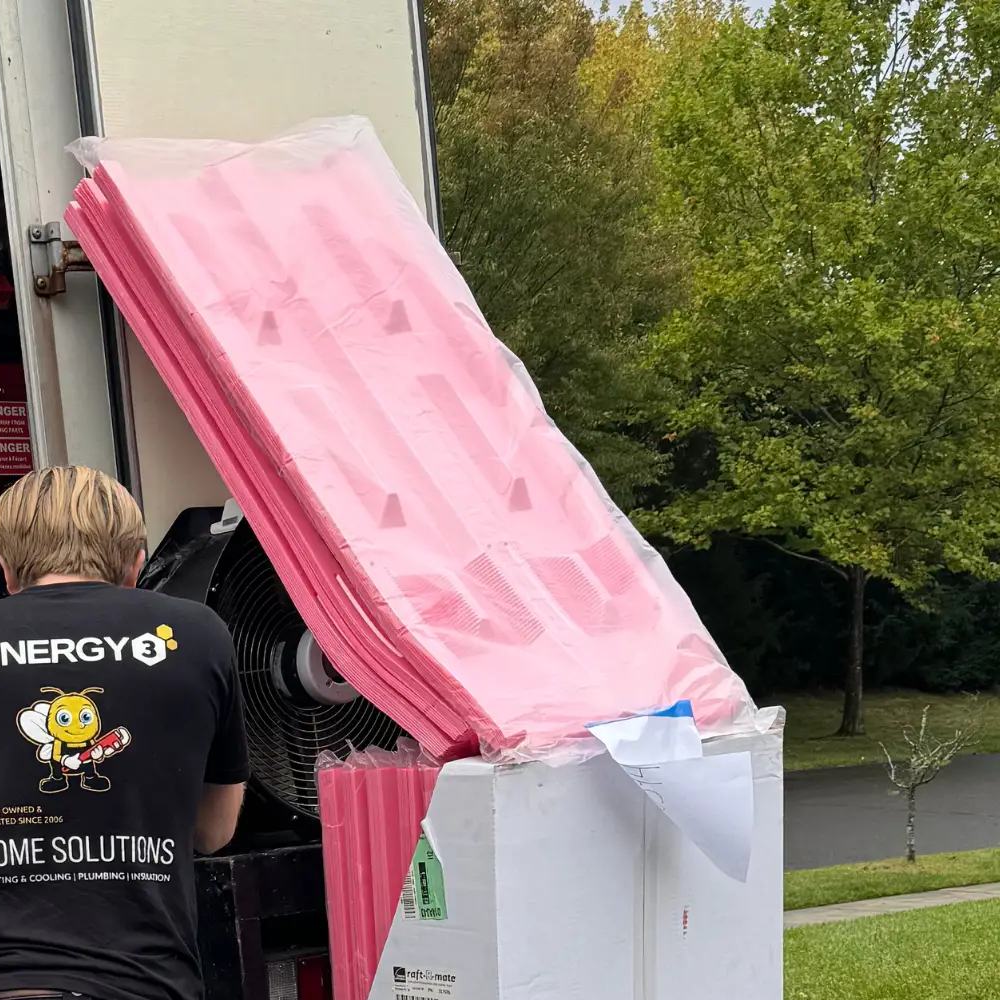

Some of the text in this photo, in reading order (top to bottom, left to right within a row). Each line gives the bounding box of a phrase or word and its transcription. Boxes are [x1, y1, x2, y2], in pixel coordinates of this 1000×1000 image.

[2, 806, 35, 815] OWNED
[18, 816, 43, 825] SINCE
[44, 816, 64, 824] 2006
[51, 835, 175, 865] SOLUTIONS
[29, 873, 71, 882] COOLING
[78, 872, 125, 881] PLUMBING
[407, 969, 456, 983] raft-R-mate
